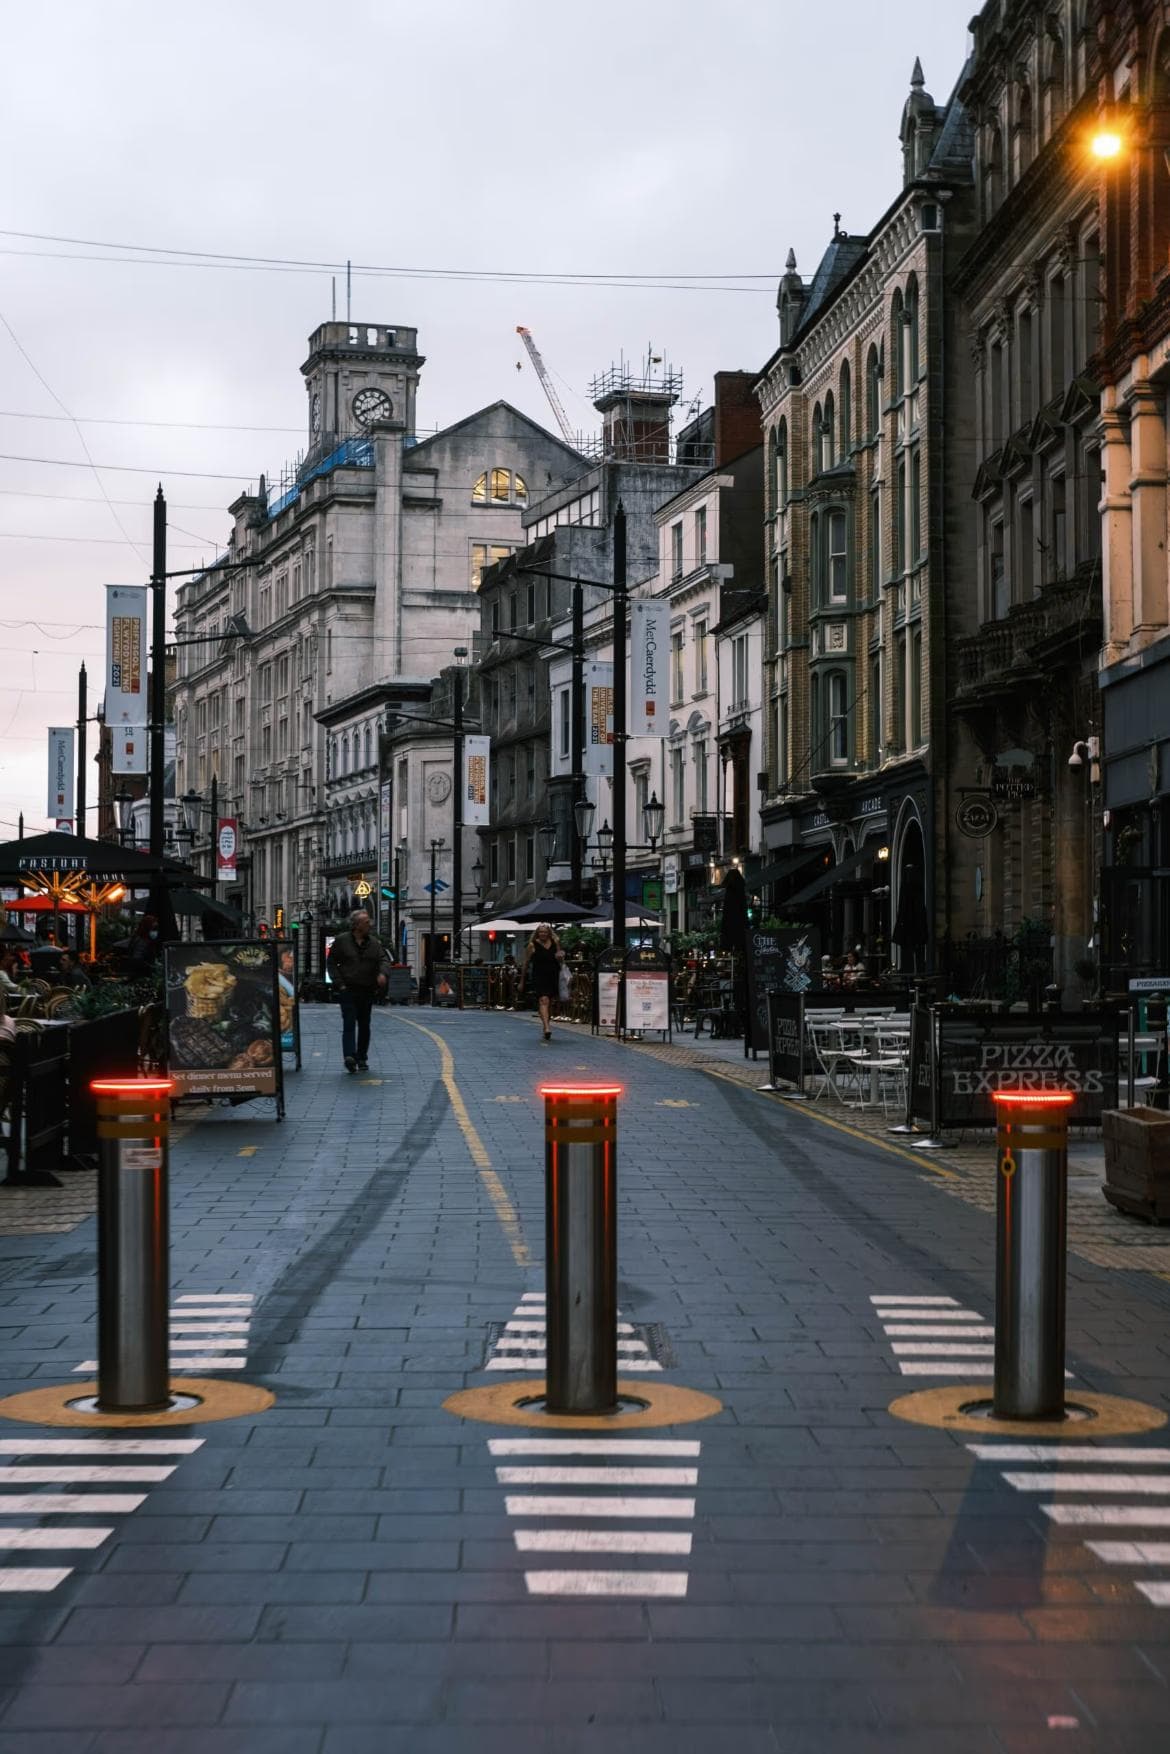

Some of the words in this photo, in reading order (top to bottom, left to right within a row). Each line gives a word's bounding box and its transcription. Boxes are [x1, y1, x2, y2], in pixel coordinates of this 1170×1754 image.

[113, 618, 121, 663] NGHYMRU
[123, 618, 131, 671] FLWYDDYN
[132, 618, 140, 669] PRIFYSGOL
[644, 619, 657, 695] MetCaerdydd
[113, 665, 121, 687] 2021
[123, 672, 131, 692] YNG
[861, 796, 881, 812] ARCADE
[18, 858, 88, 868] PASTURE
[980, 1045, 1077, 1068] PIZZA
[171, 1072, 186, 1080] Set
[187, 1071, 216, 1080] dinner
[243, 1070, 272, 1078] served
[952, 1070, 1105, 1094] EXPRESS
[189, 1084, 210, 1094] daily
[212, 1084, 235, 1093] from
[235, 1084, 256, 1093] 5pm
